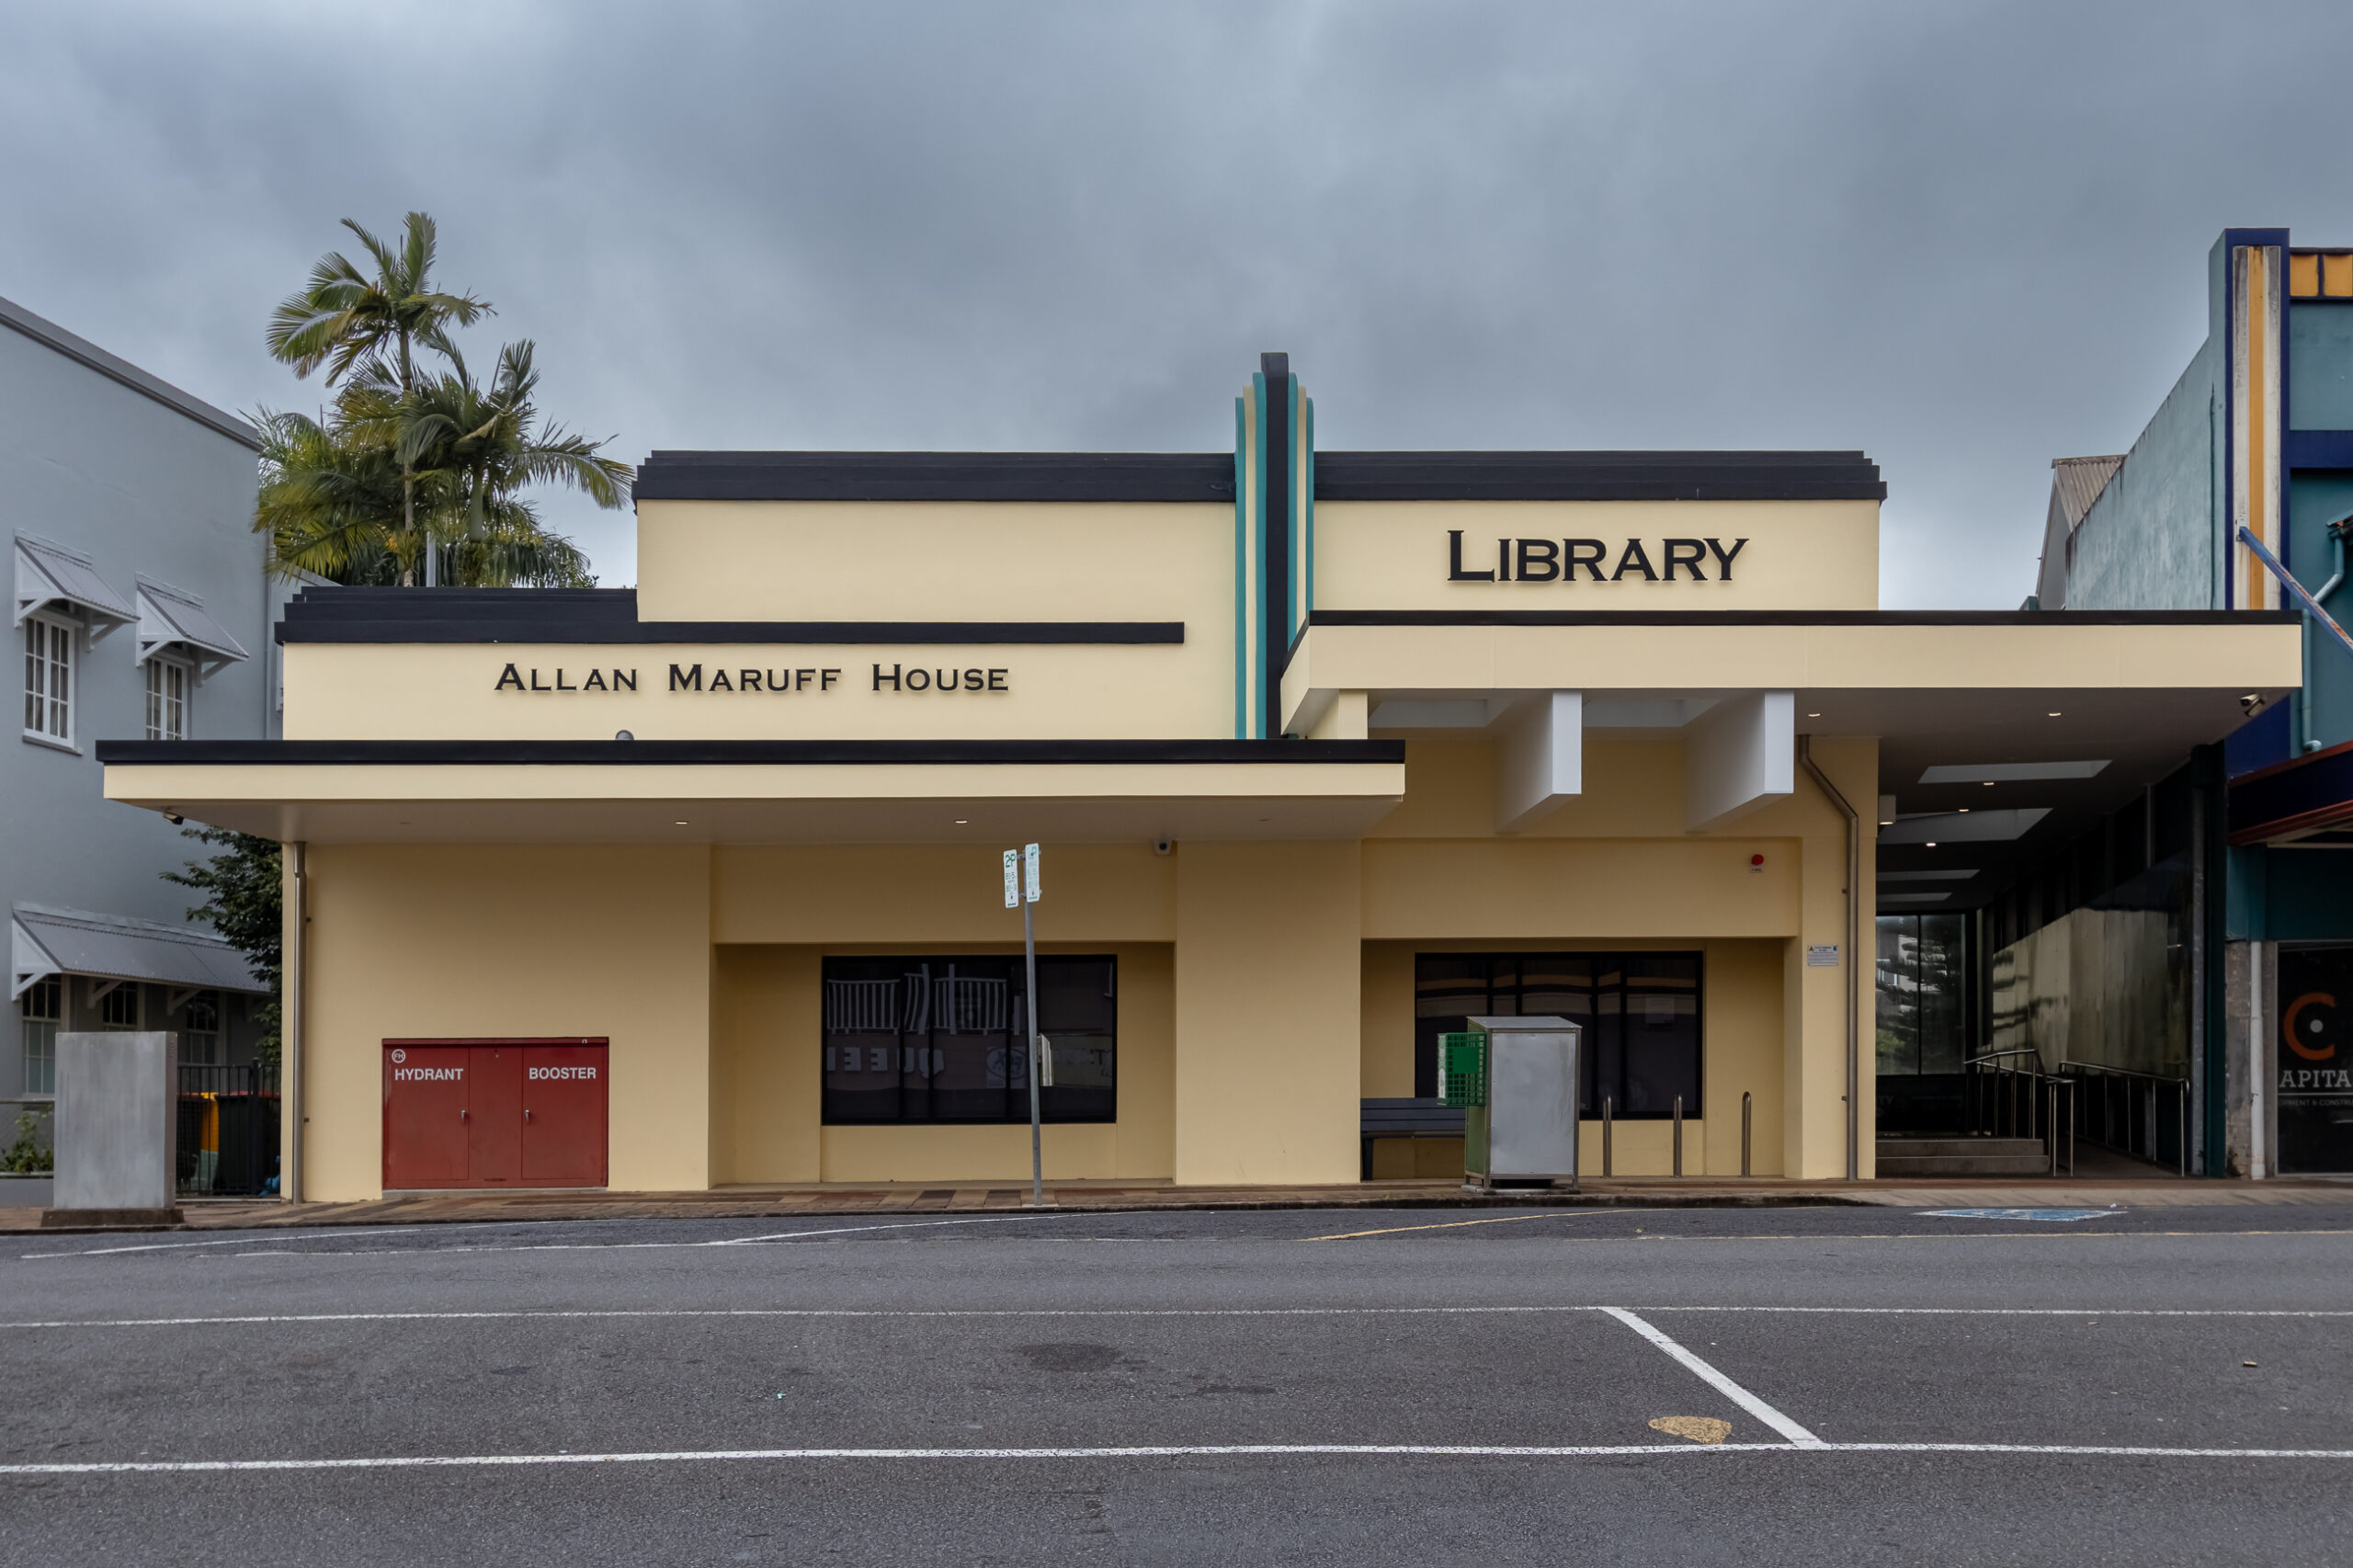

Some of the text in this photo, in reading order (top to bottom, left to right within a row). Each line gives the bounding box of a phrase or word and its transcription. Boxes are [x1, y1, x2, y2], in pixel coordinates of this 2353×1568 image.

[1447, 529, 1750, 584] LIBRARY
[494, 663, 1009, 692] ALLAN MARUFF HOUSE
[1005, 853, 1016, 868] 2P
[394, 1067, 597, 1081] HYDRANT BOOSTER
